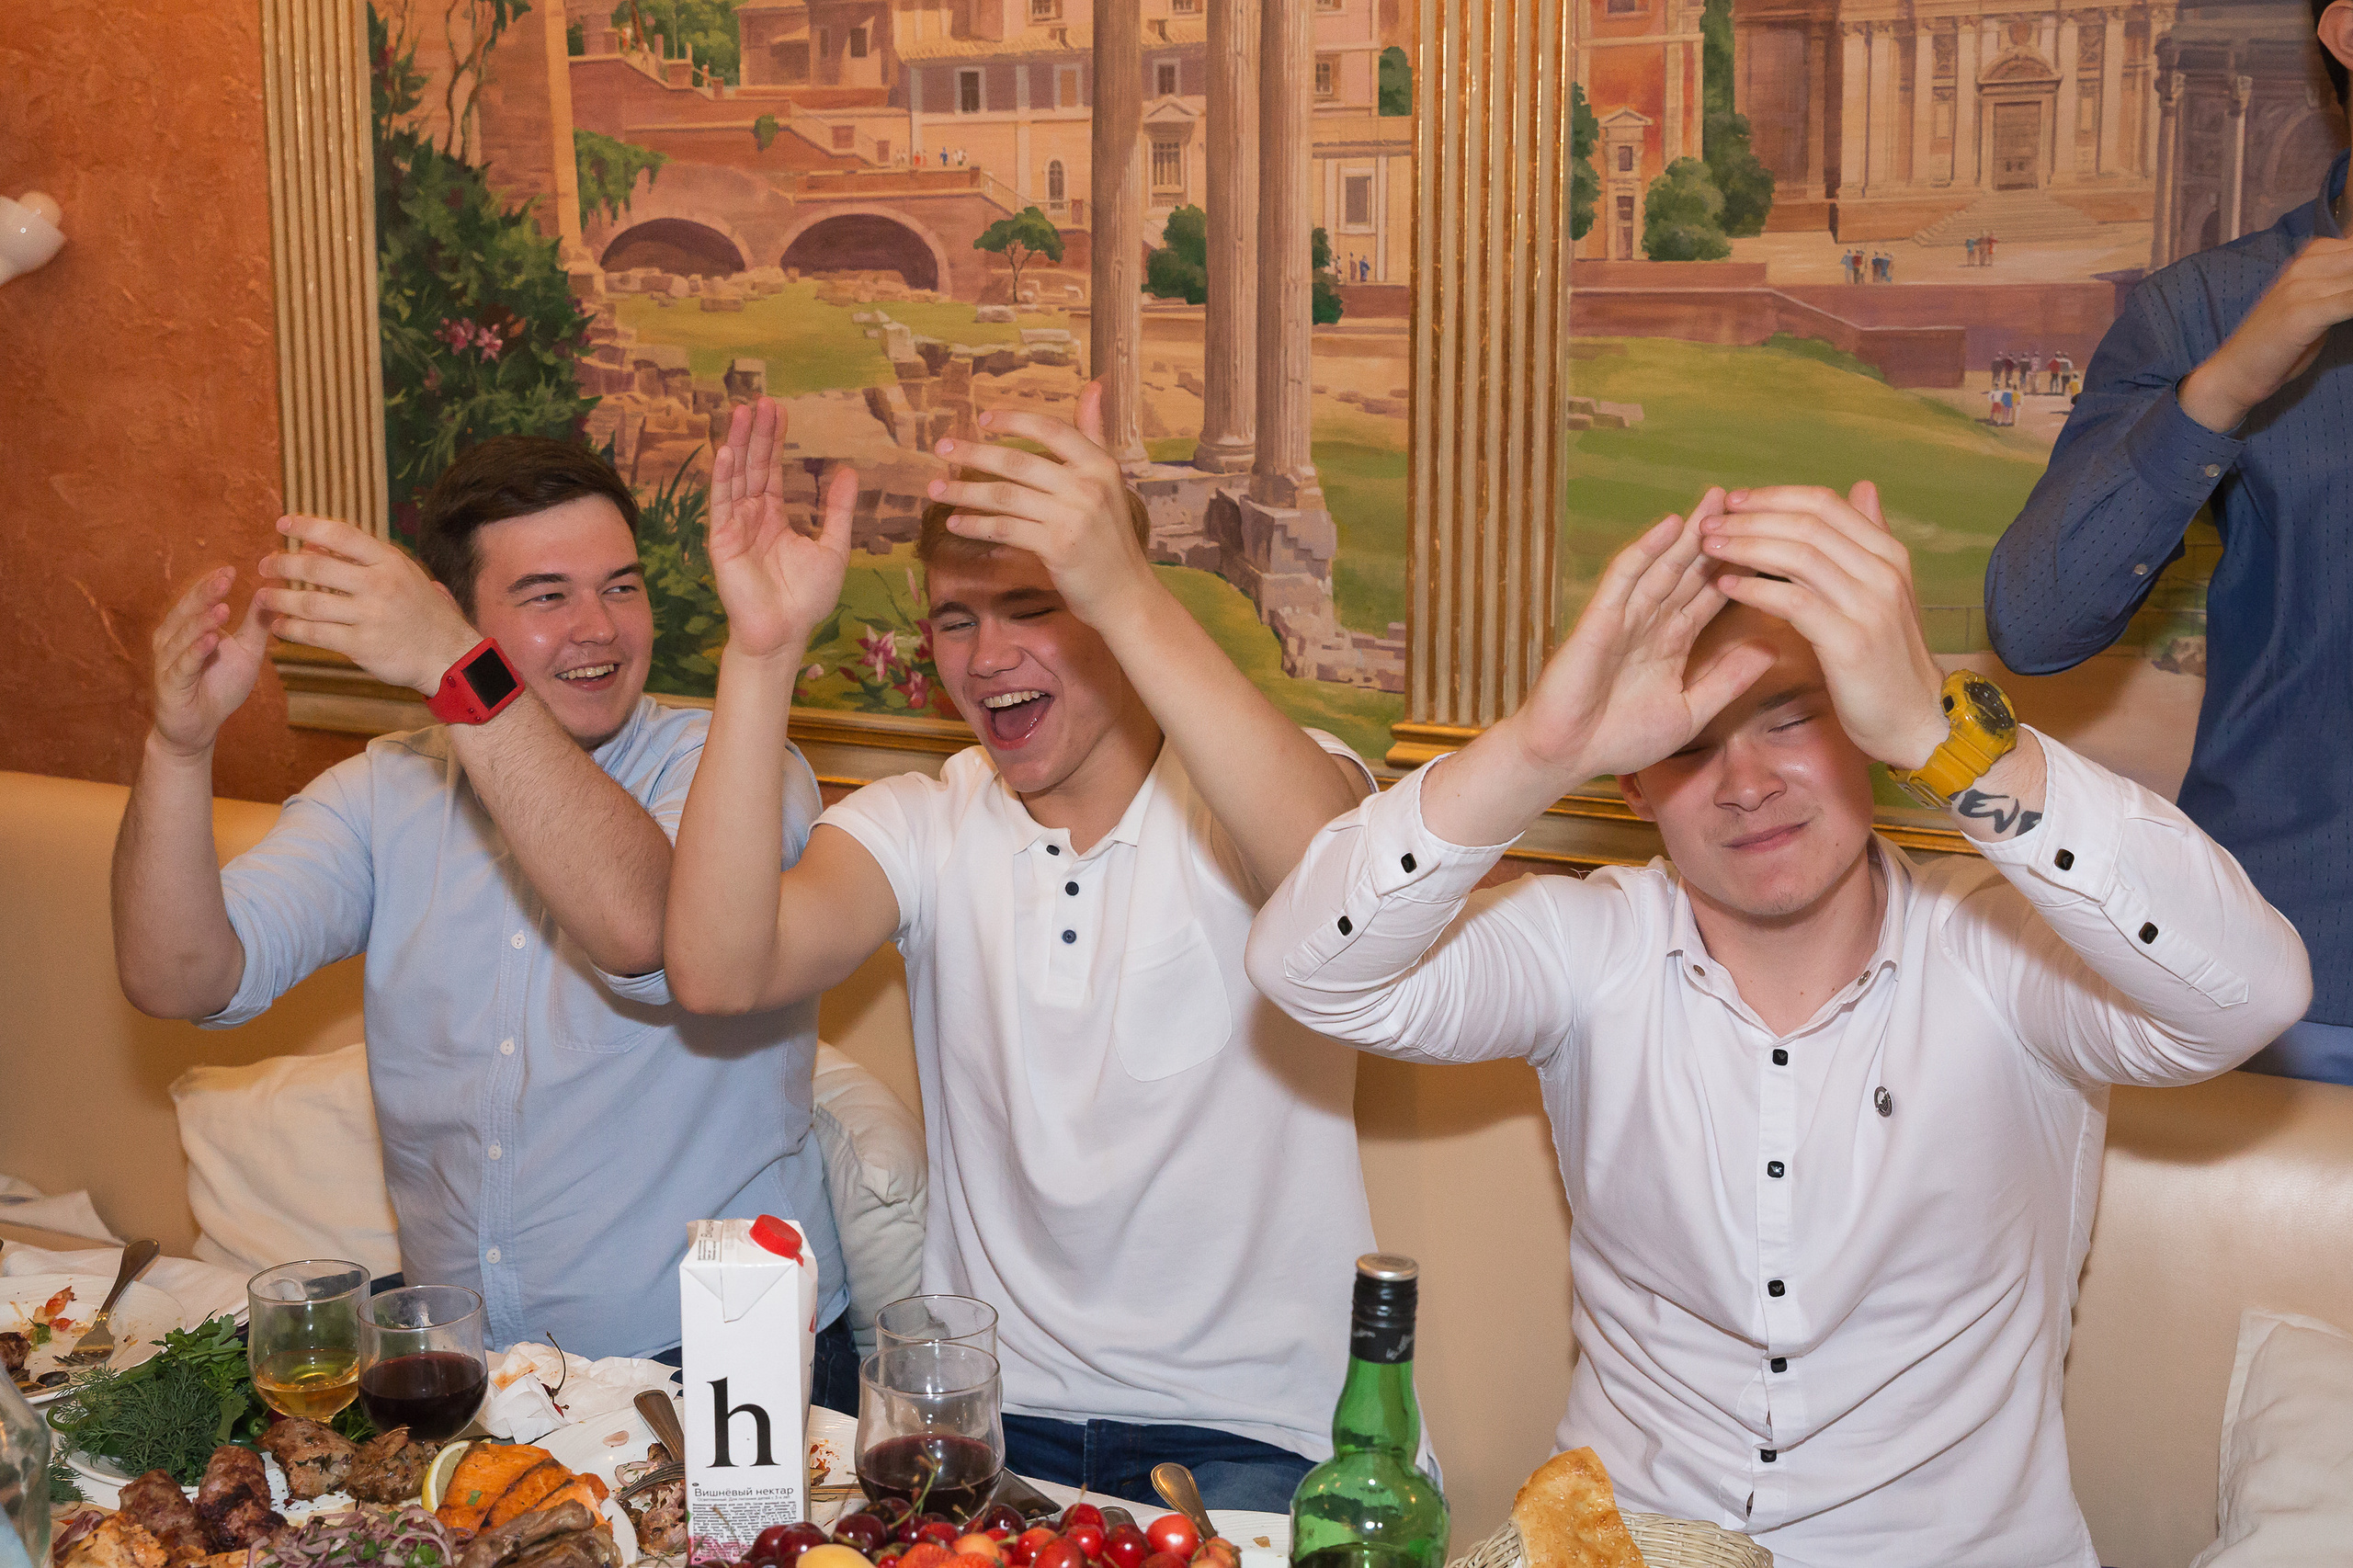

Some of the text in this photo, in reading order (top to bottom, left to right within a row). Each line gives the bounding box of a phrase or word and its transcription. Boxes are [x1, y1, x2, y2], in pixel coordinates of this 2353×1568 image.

[706, 1377, 781, 1468] h
[694, 1487, 794, 1497] Вишнёвый нектар
